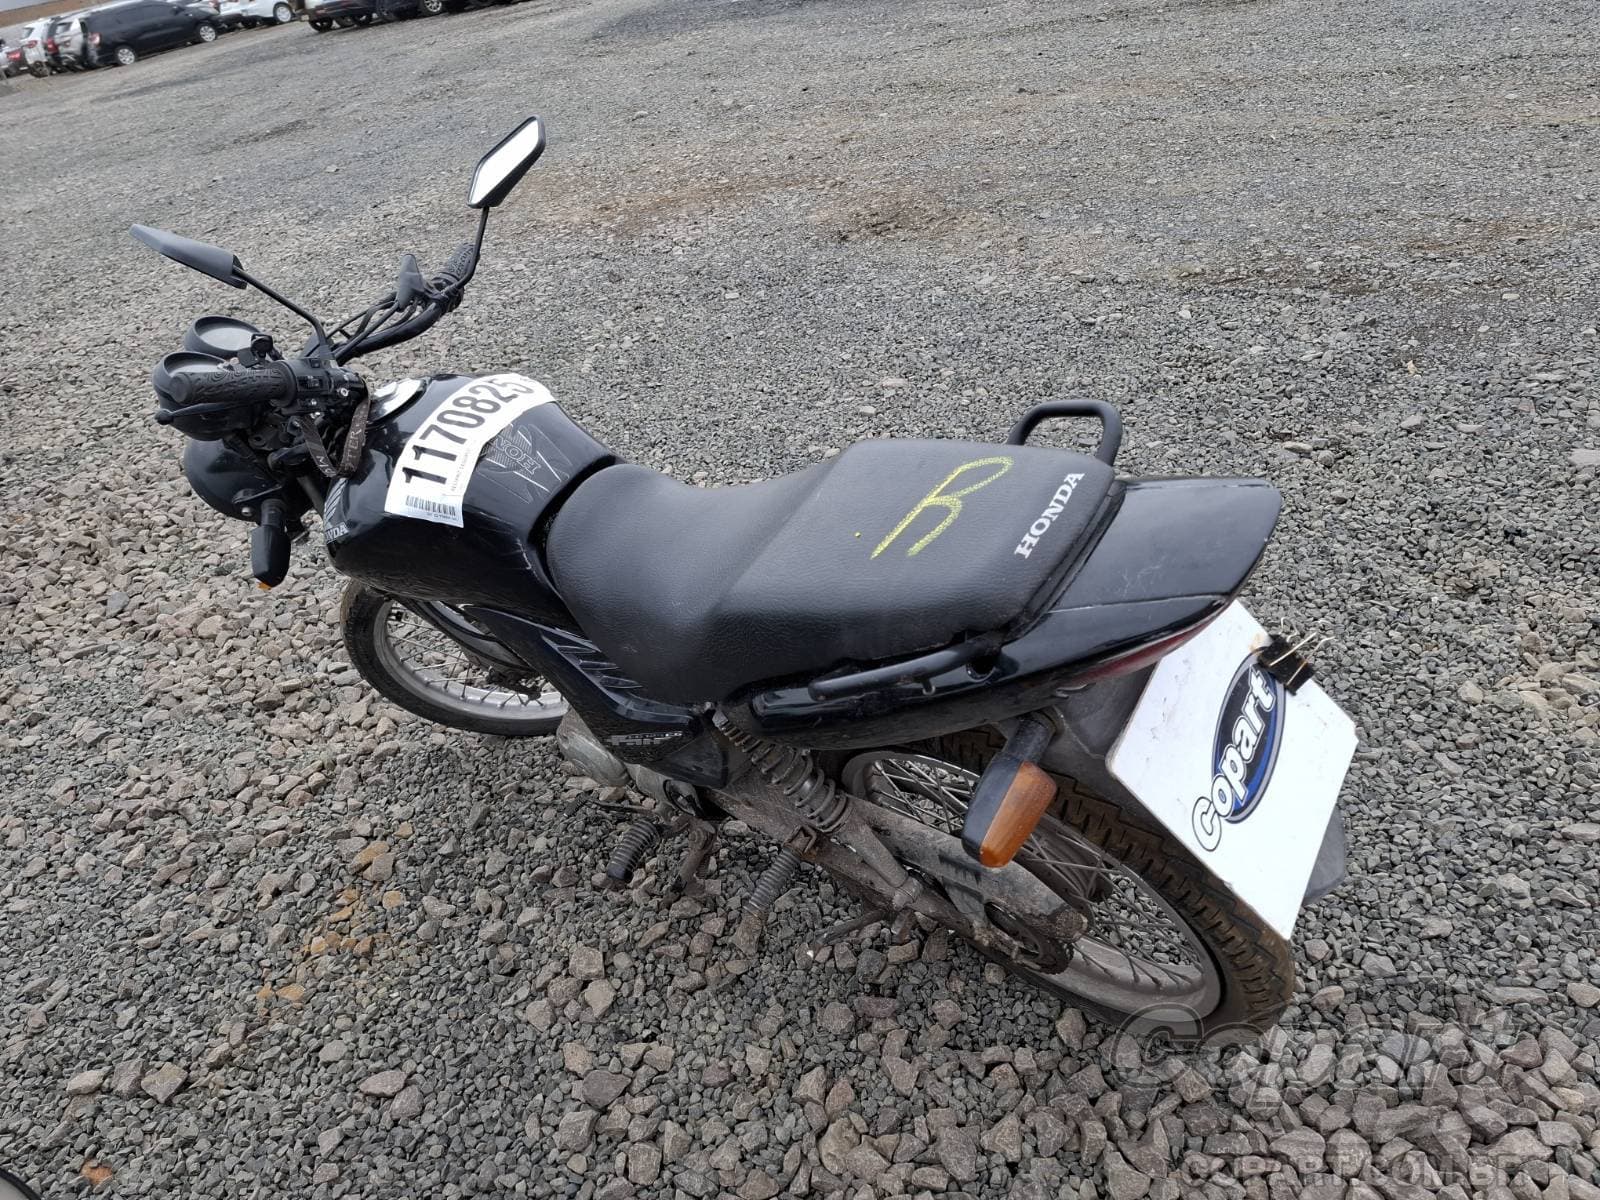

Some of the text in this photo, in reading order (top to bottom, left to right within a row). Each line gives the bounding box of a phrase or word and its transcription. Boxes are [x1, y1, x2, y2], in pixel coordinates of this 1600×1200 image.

[402, 378, 534, 485] 1170825
[494, 433, 541, 475] HON
[1014, 471, 1086, 559] HONDA
[1192, 663, 1277, 852] Copart
